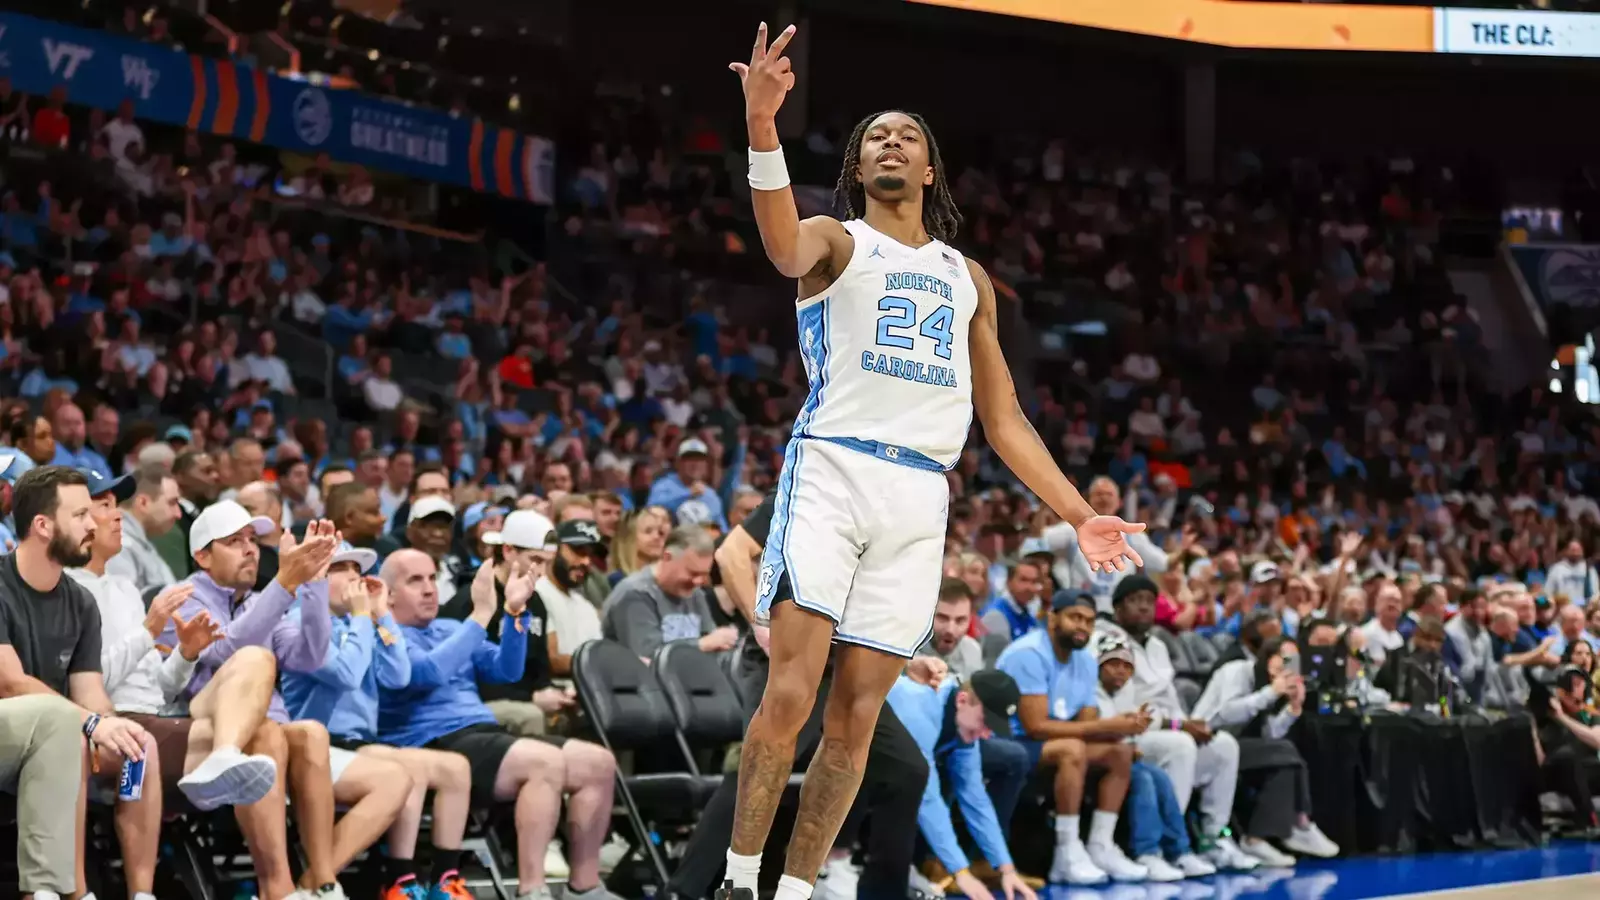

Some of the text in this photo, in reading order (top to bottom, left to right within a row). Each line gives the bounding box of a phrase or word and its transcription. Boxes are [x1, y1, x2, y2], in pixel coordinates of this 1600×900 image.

[1471, 22, 1510, 45] THE
[42, 37, 93, 79] VT
[885, 272, 953, 302] NORTH
[875, 295, 955, 361] 24
[861, 350, 957, 388] CAROLINA
